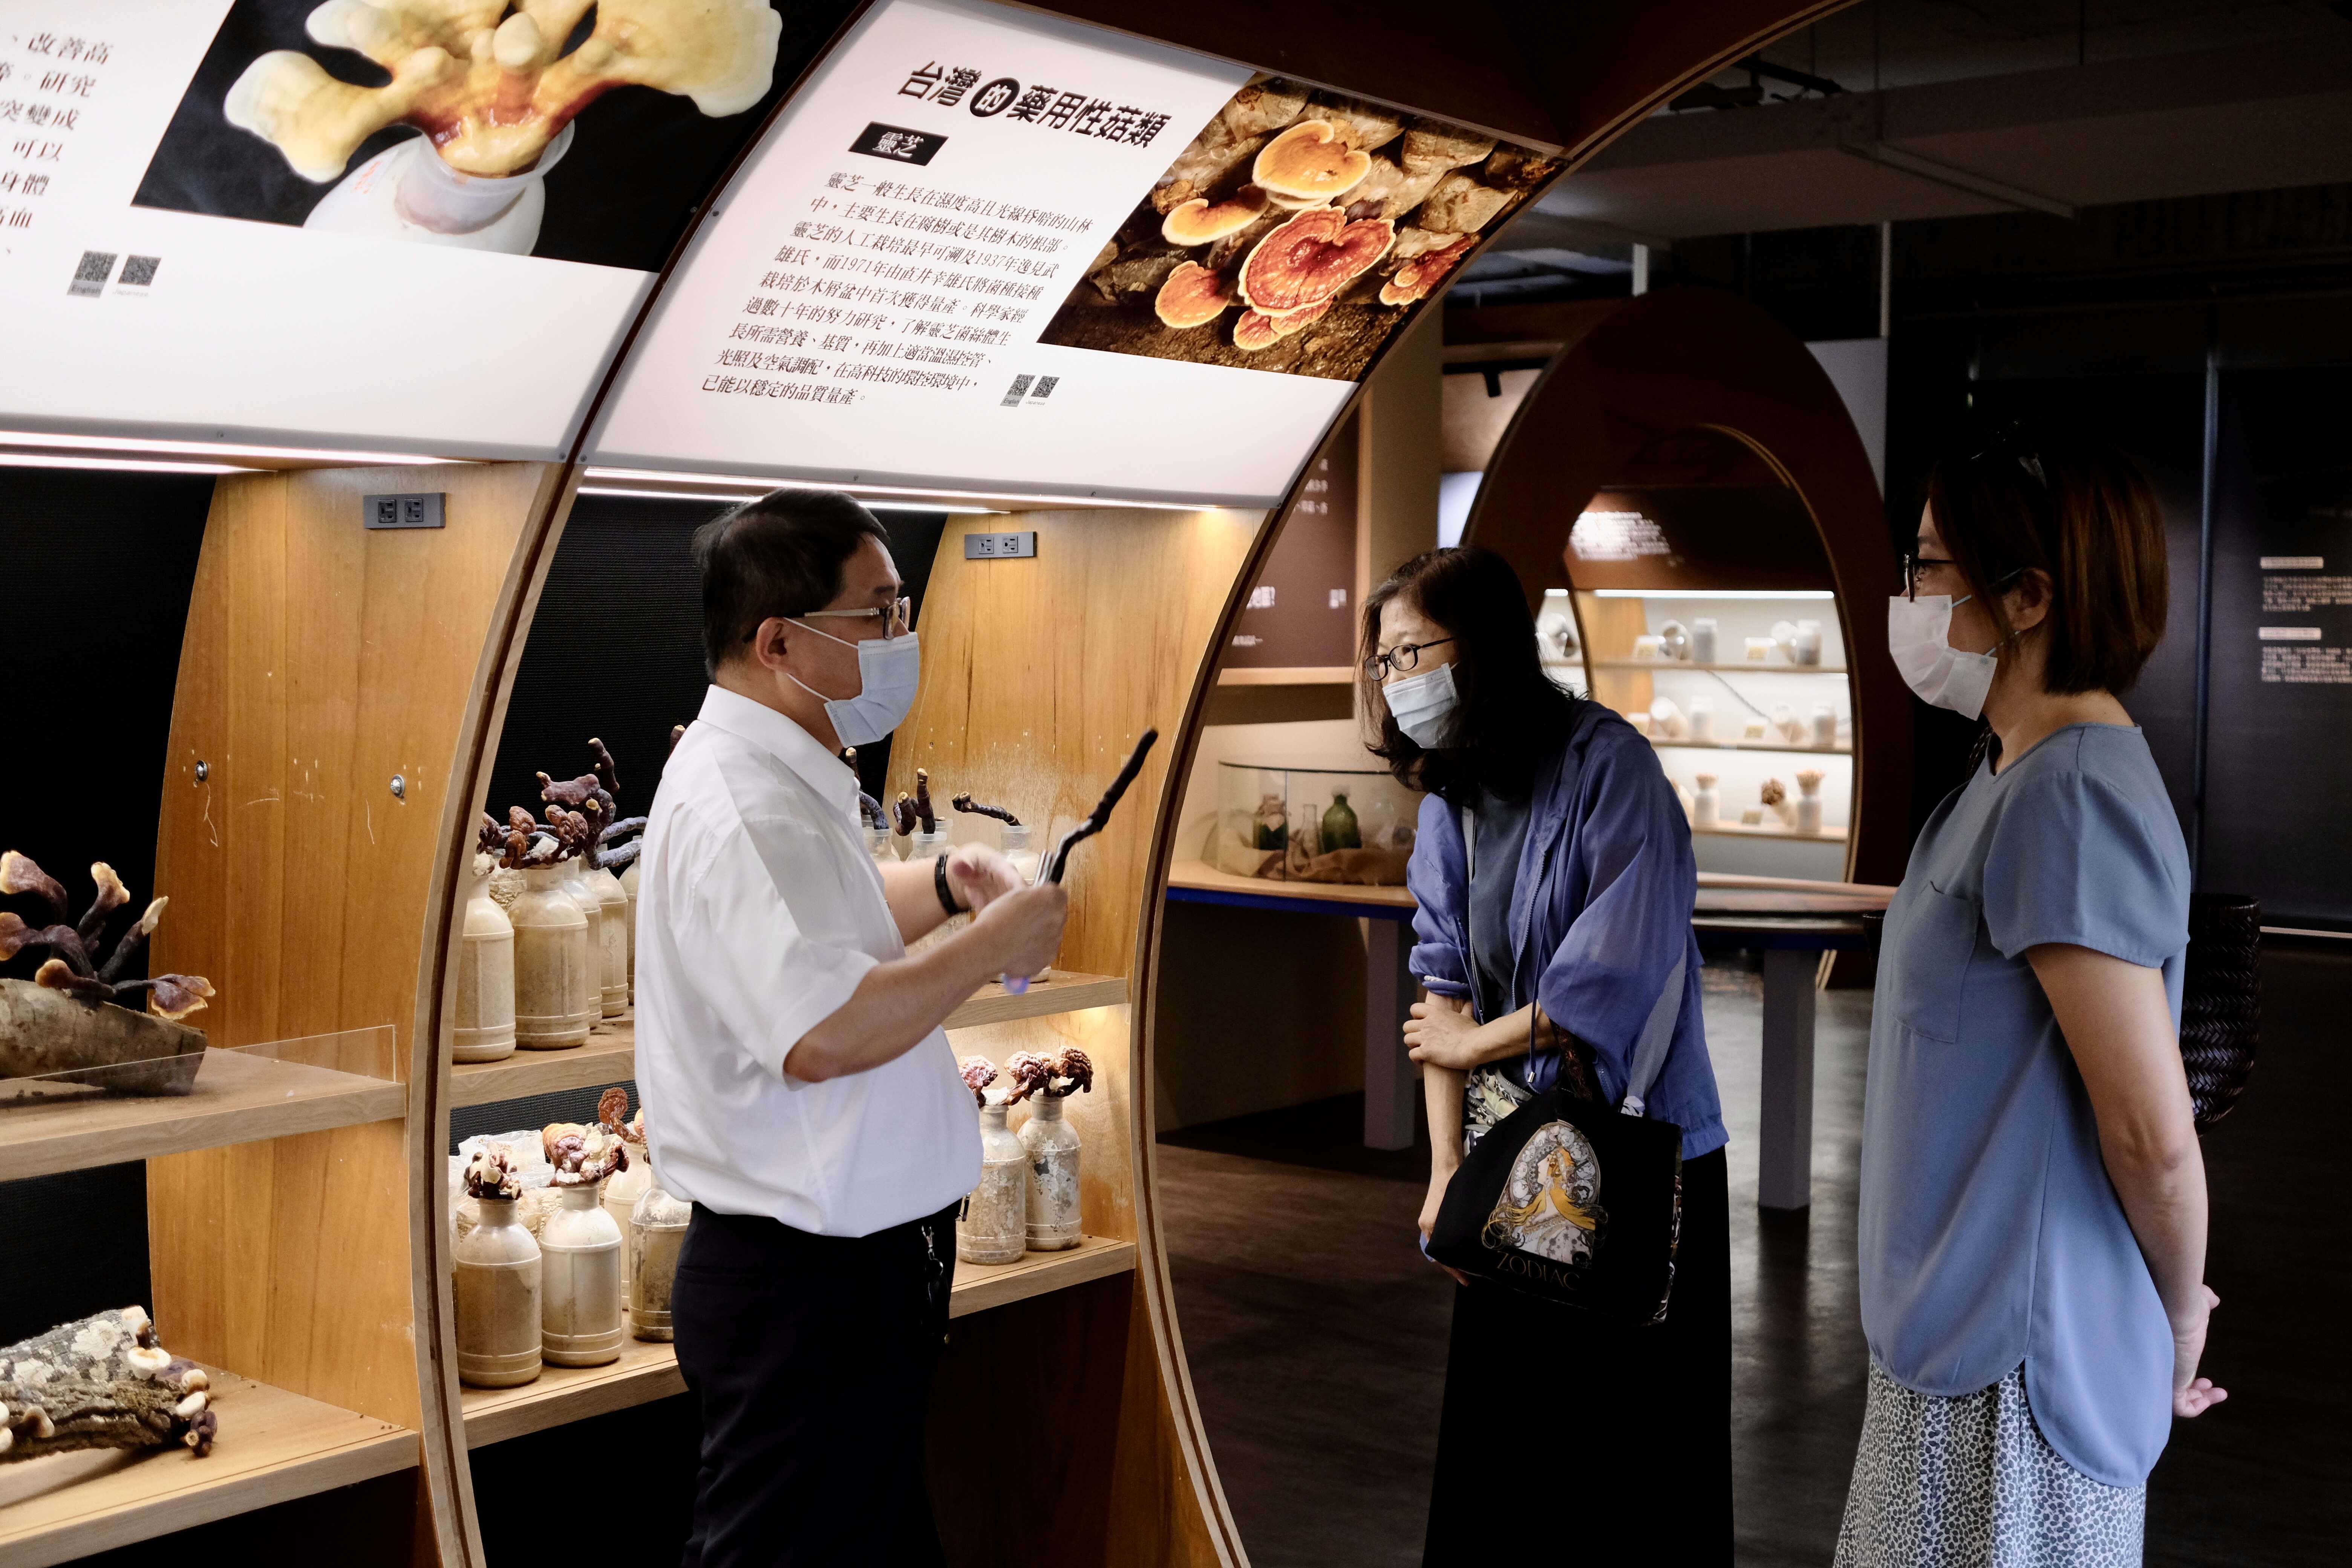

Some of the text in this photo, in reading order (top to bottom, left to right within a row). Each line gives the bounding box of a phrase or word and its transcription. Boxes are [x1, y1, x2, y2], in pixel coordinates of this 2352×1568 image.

[897, 60, 1172, 149] 台灣的藥用性菇類
[12, 137, 63, 162] 可以
[872, 131, 925, 158] 靈芝
[824, 172, 1093, 233] 靈芝一般生長在濕度高且光線昏暗的山林
[790, 220, 1059, 279] 靈芝的人工栽培最早可溯及1937年逸見武
[742, 296, 1012, 346] 過數十年的努力研究，了解靈芝菌絲體生
[702, 375, 865, 405] 已能以穩定的品質量產。
[1497, 1251, 1580, 1291] ZODIAC
